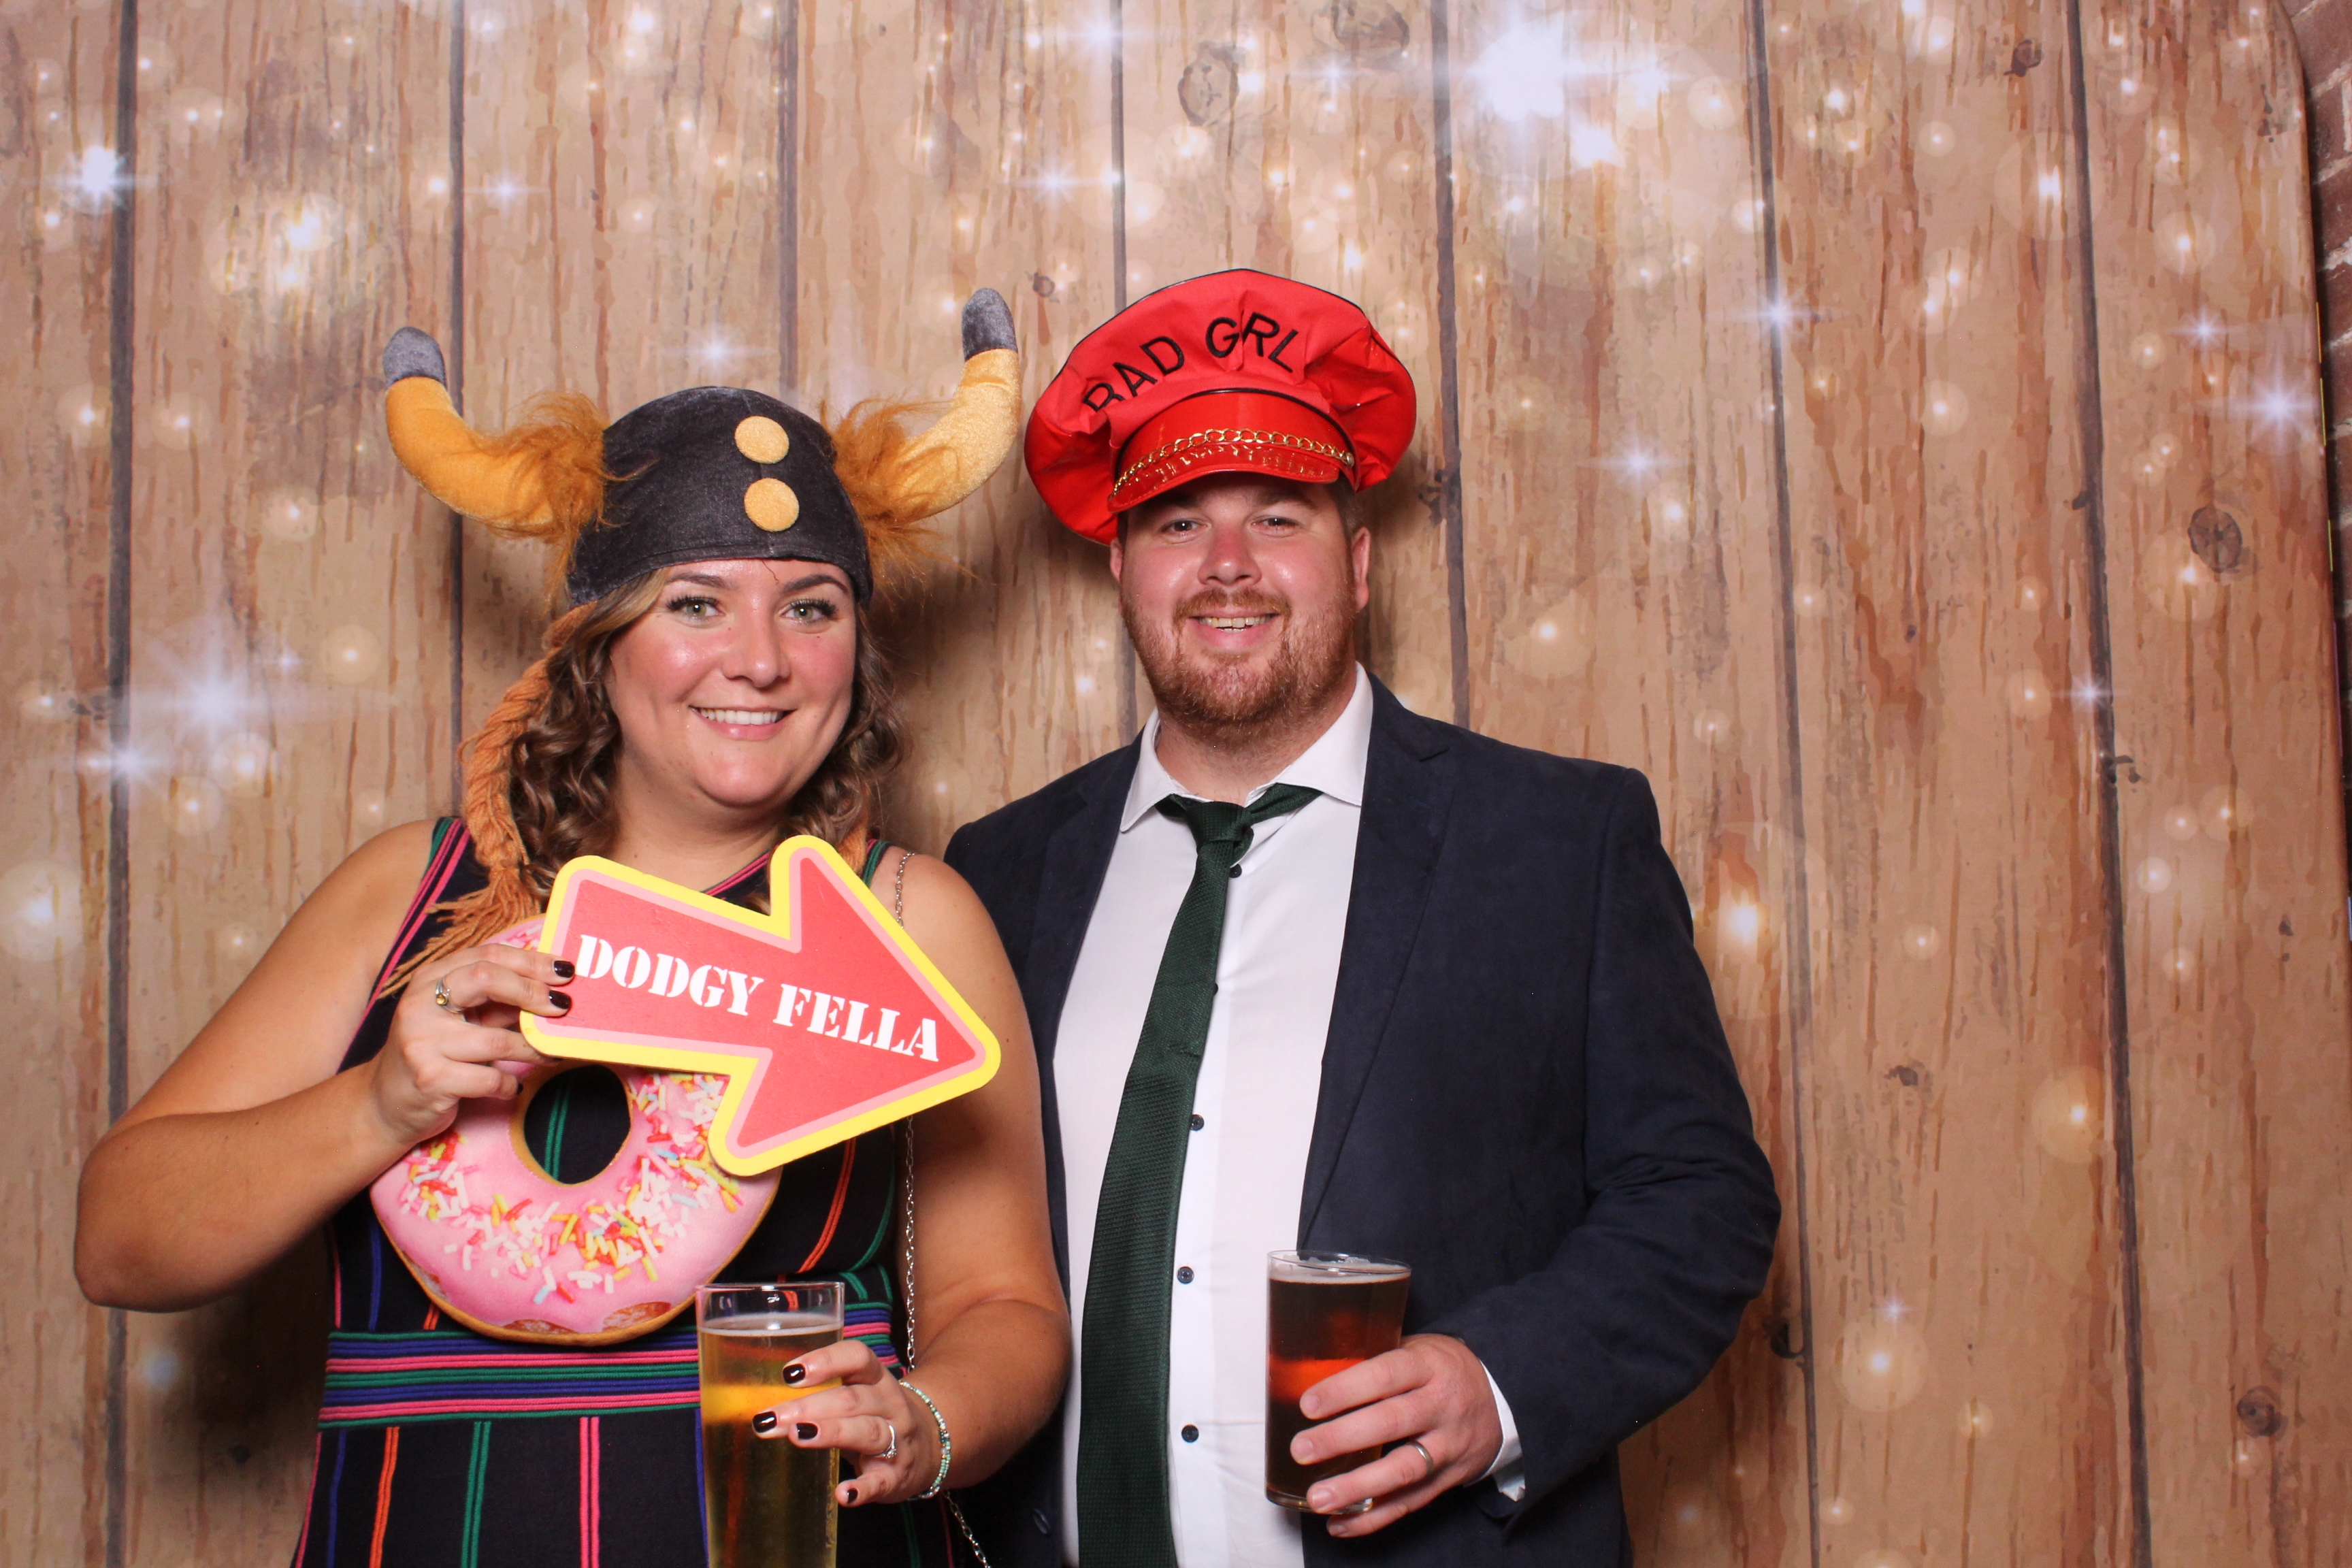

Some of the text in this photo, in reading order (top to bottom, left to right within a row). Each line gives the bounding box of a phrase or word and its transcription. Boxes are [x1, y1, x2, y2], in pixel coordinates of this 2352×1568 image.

[1205, 312, 1298, 373] GRL
[574, 934, 940, 1063] DODGY FELLA
